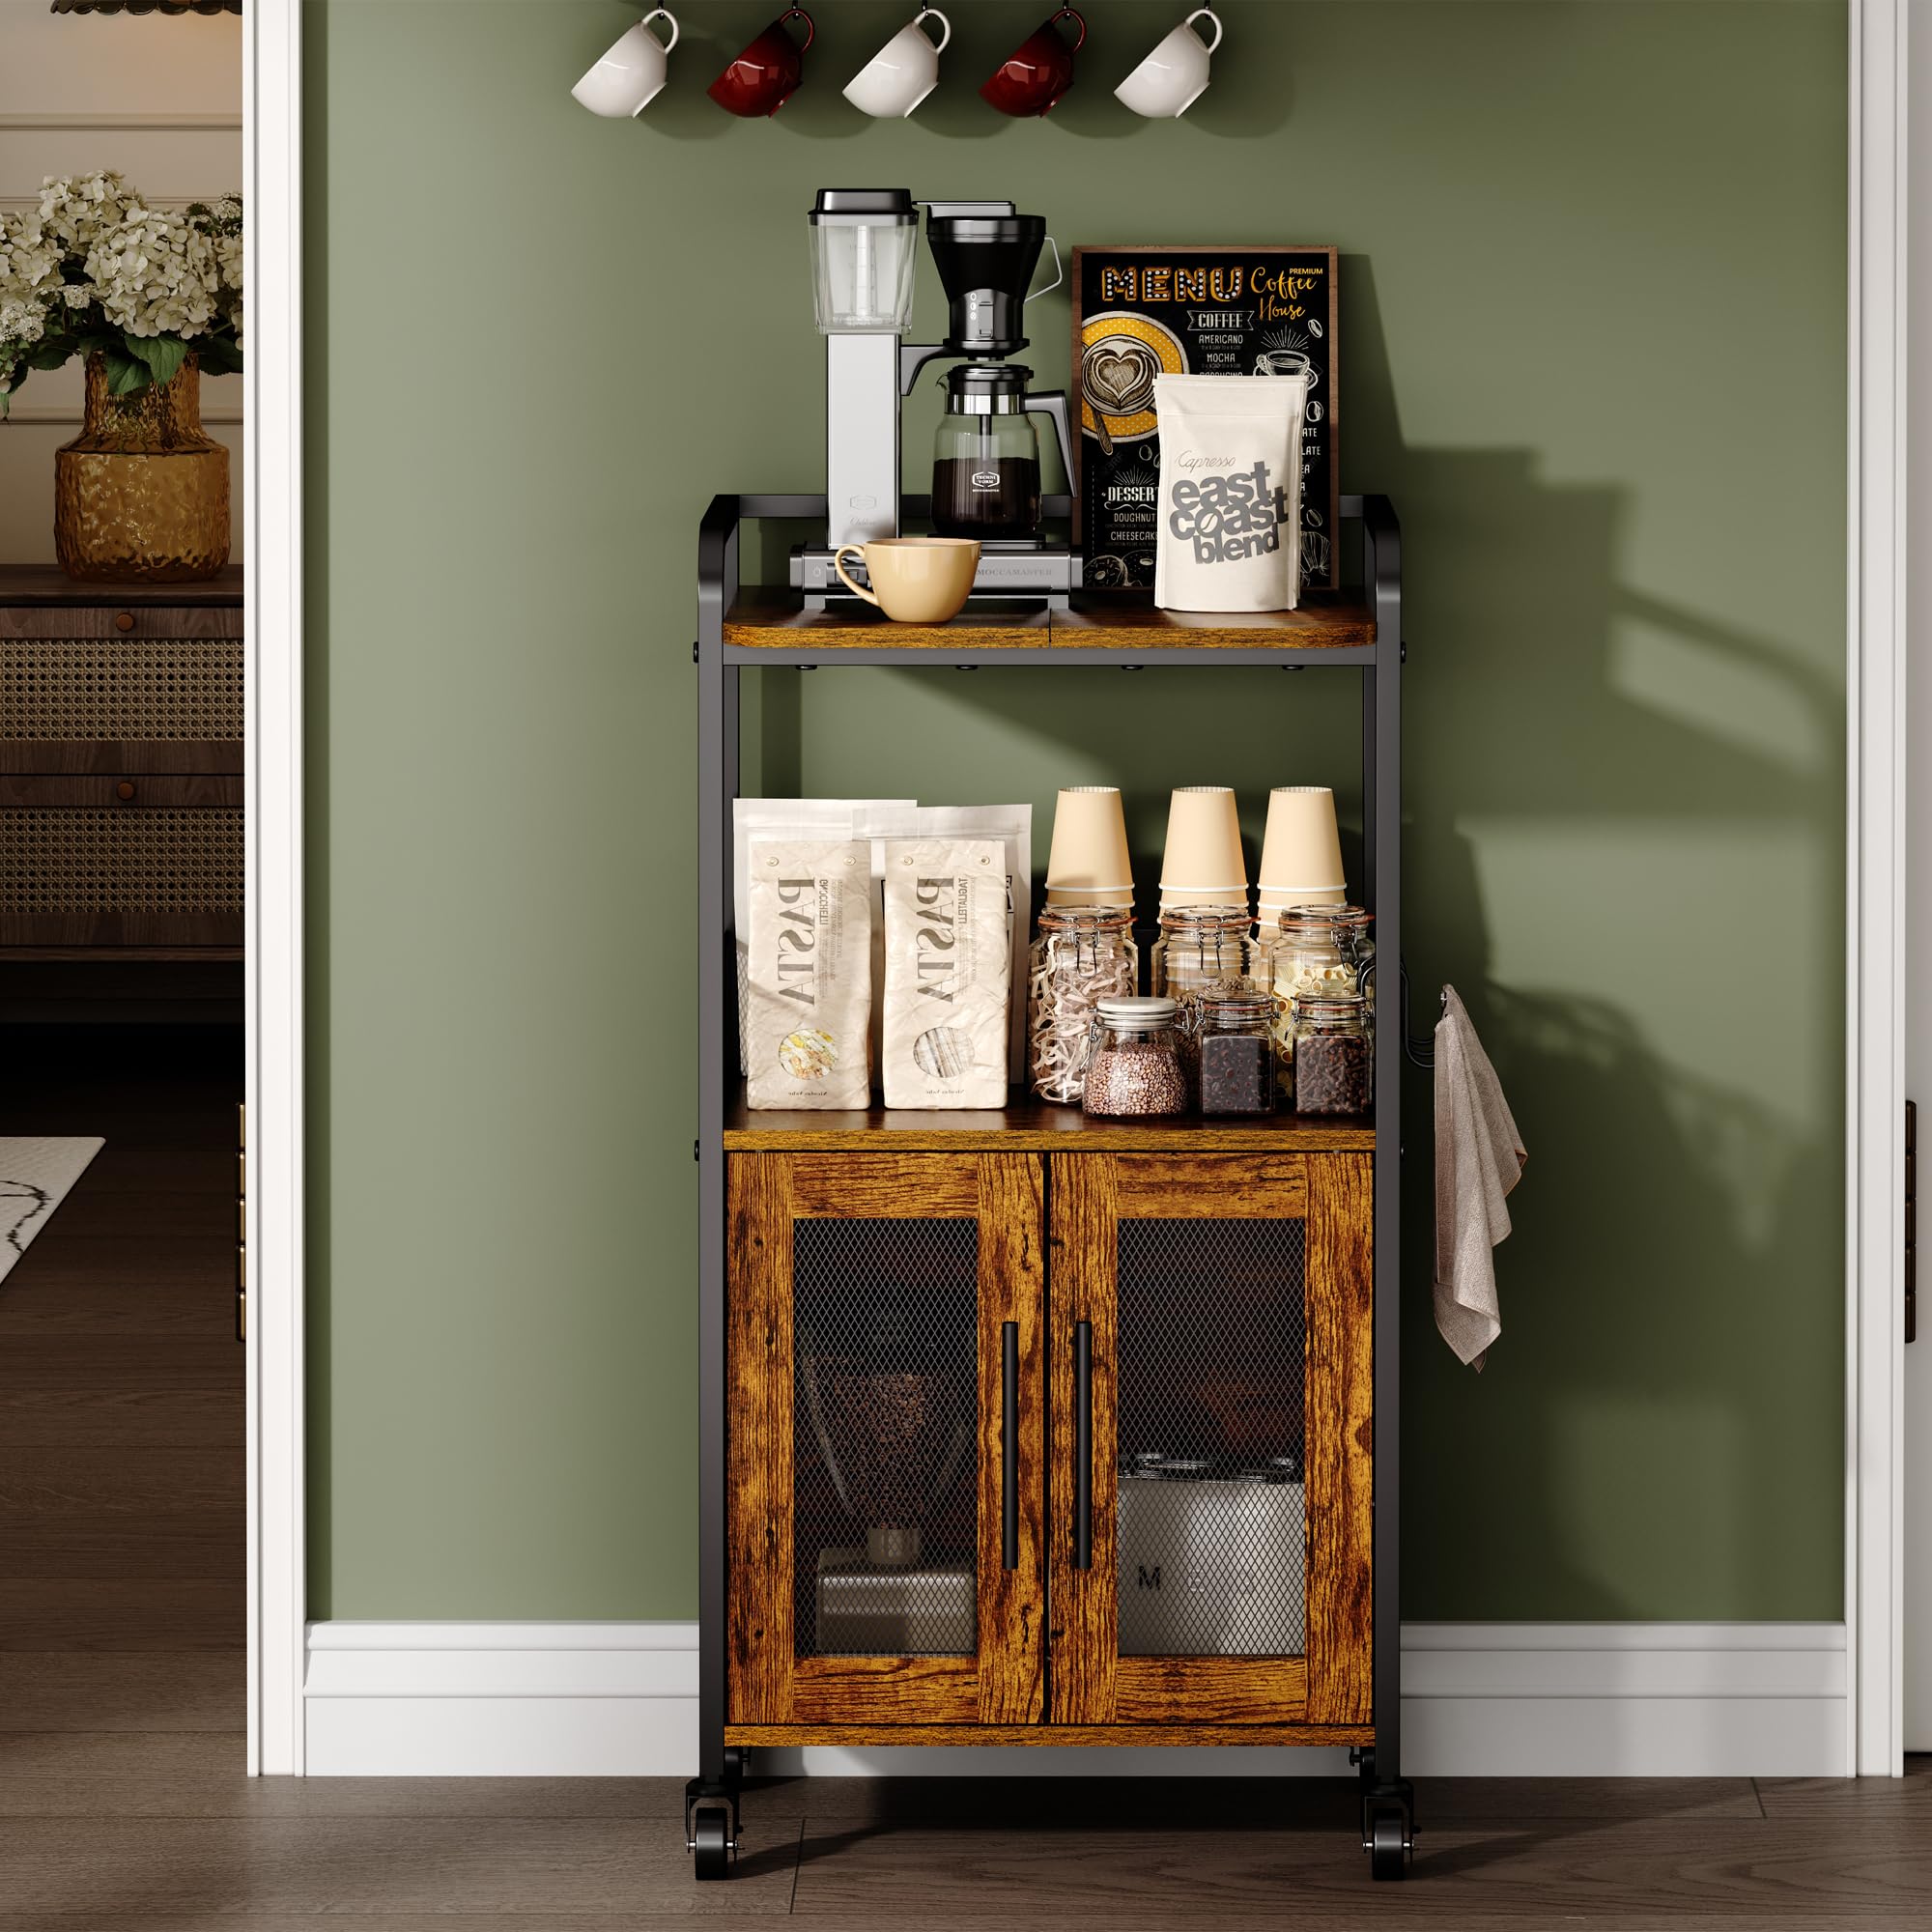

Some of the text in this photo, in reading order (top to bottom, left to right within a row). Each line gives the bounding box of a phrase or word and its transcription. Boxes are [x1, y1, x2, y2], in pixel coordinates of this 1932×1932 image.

[1101, 266, 1243, 302] MENU
[1250, 267, 1318, 299] Coffee
[1198, 312, 1243, 328] COFFEE
[1259, 295, 1306, 322] House
[1198, 334, 1243, 344] AMERICANO
[1207, 353, 1236, 362] MOCHA
[1176, 449, 1236, 473] Capresso
[1171, 460, 1271, 511] east
[1114, 512, 1156, 523] DOUGHNUT
[1169, 485, 1289, 540] coast
[1192, 523, 1281, 565] blend
